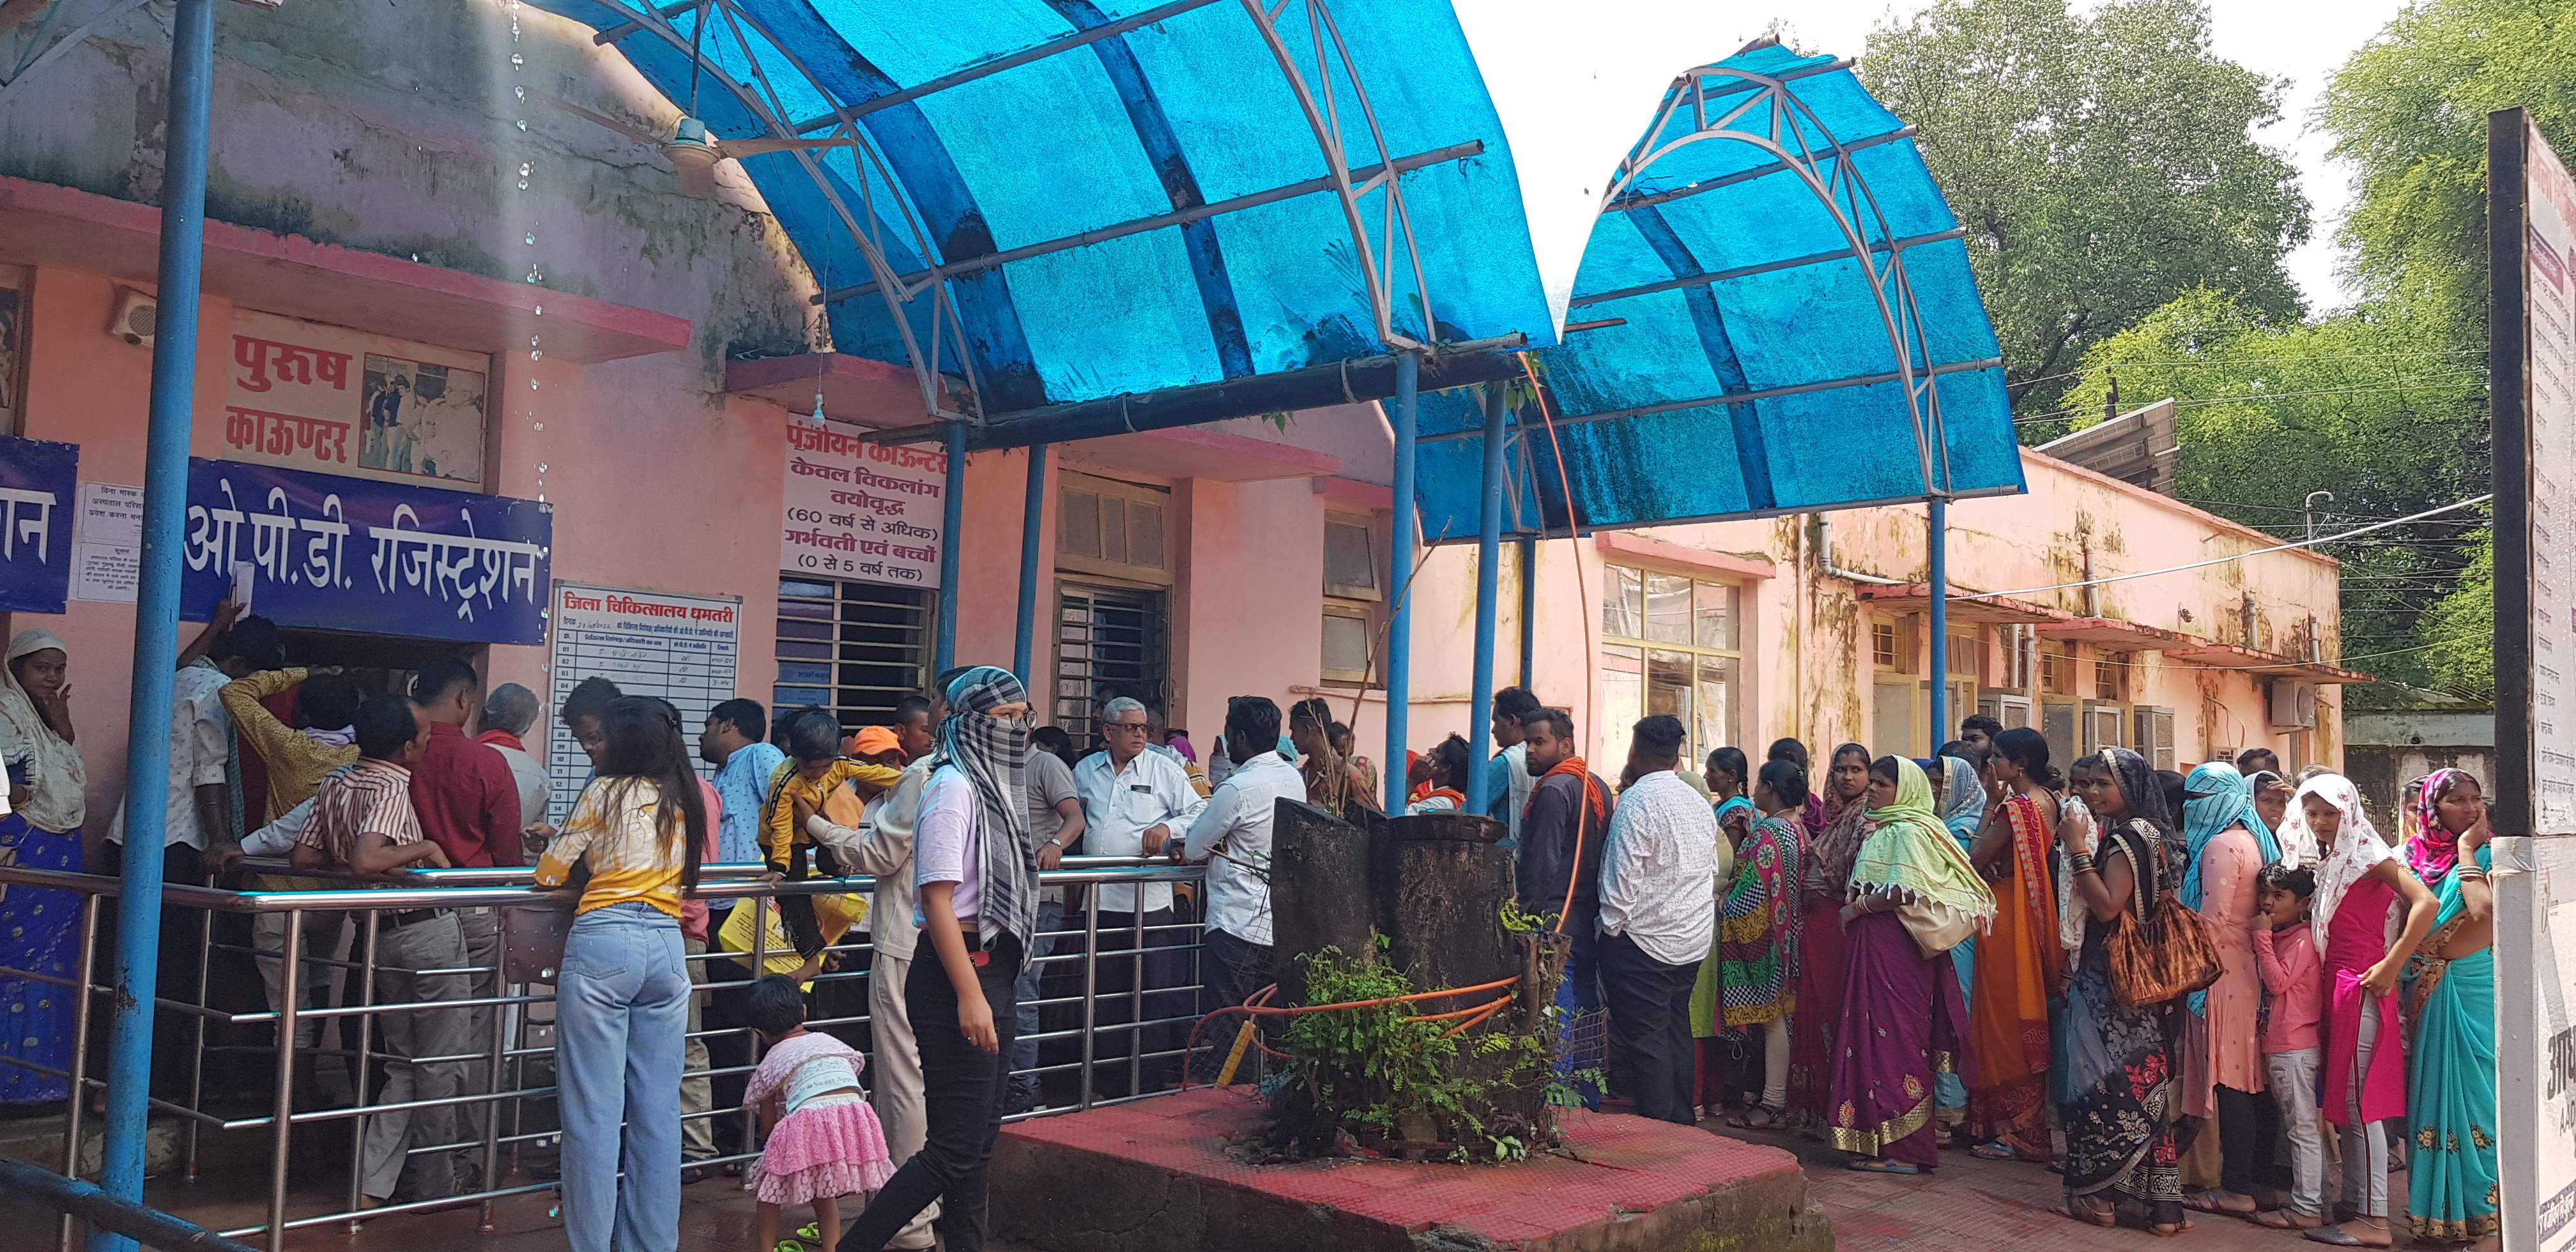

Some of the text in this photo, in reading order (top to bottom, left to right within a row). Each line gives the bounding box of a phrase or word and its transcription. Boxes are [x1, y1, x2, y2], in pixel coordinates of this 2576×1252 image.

[790, 456, 940, 498] केवल विकलांग
[125, 500, 143, 510] परिस
[830, 489, 906, 515] वयोवृद्ध
[787, 507, 938, 542] (60 वर्ष से अधिक)
[785, 528, 937, 563] गर्भवती एवं बच्चों
[369, 503, 540, 623] रजिस्ट्रेशन
[798, 554, 923, 582] (0 से 5 वर्ष तक)
[564, 591, 734, 623] जिला चिकित्सालय धमतरी
